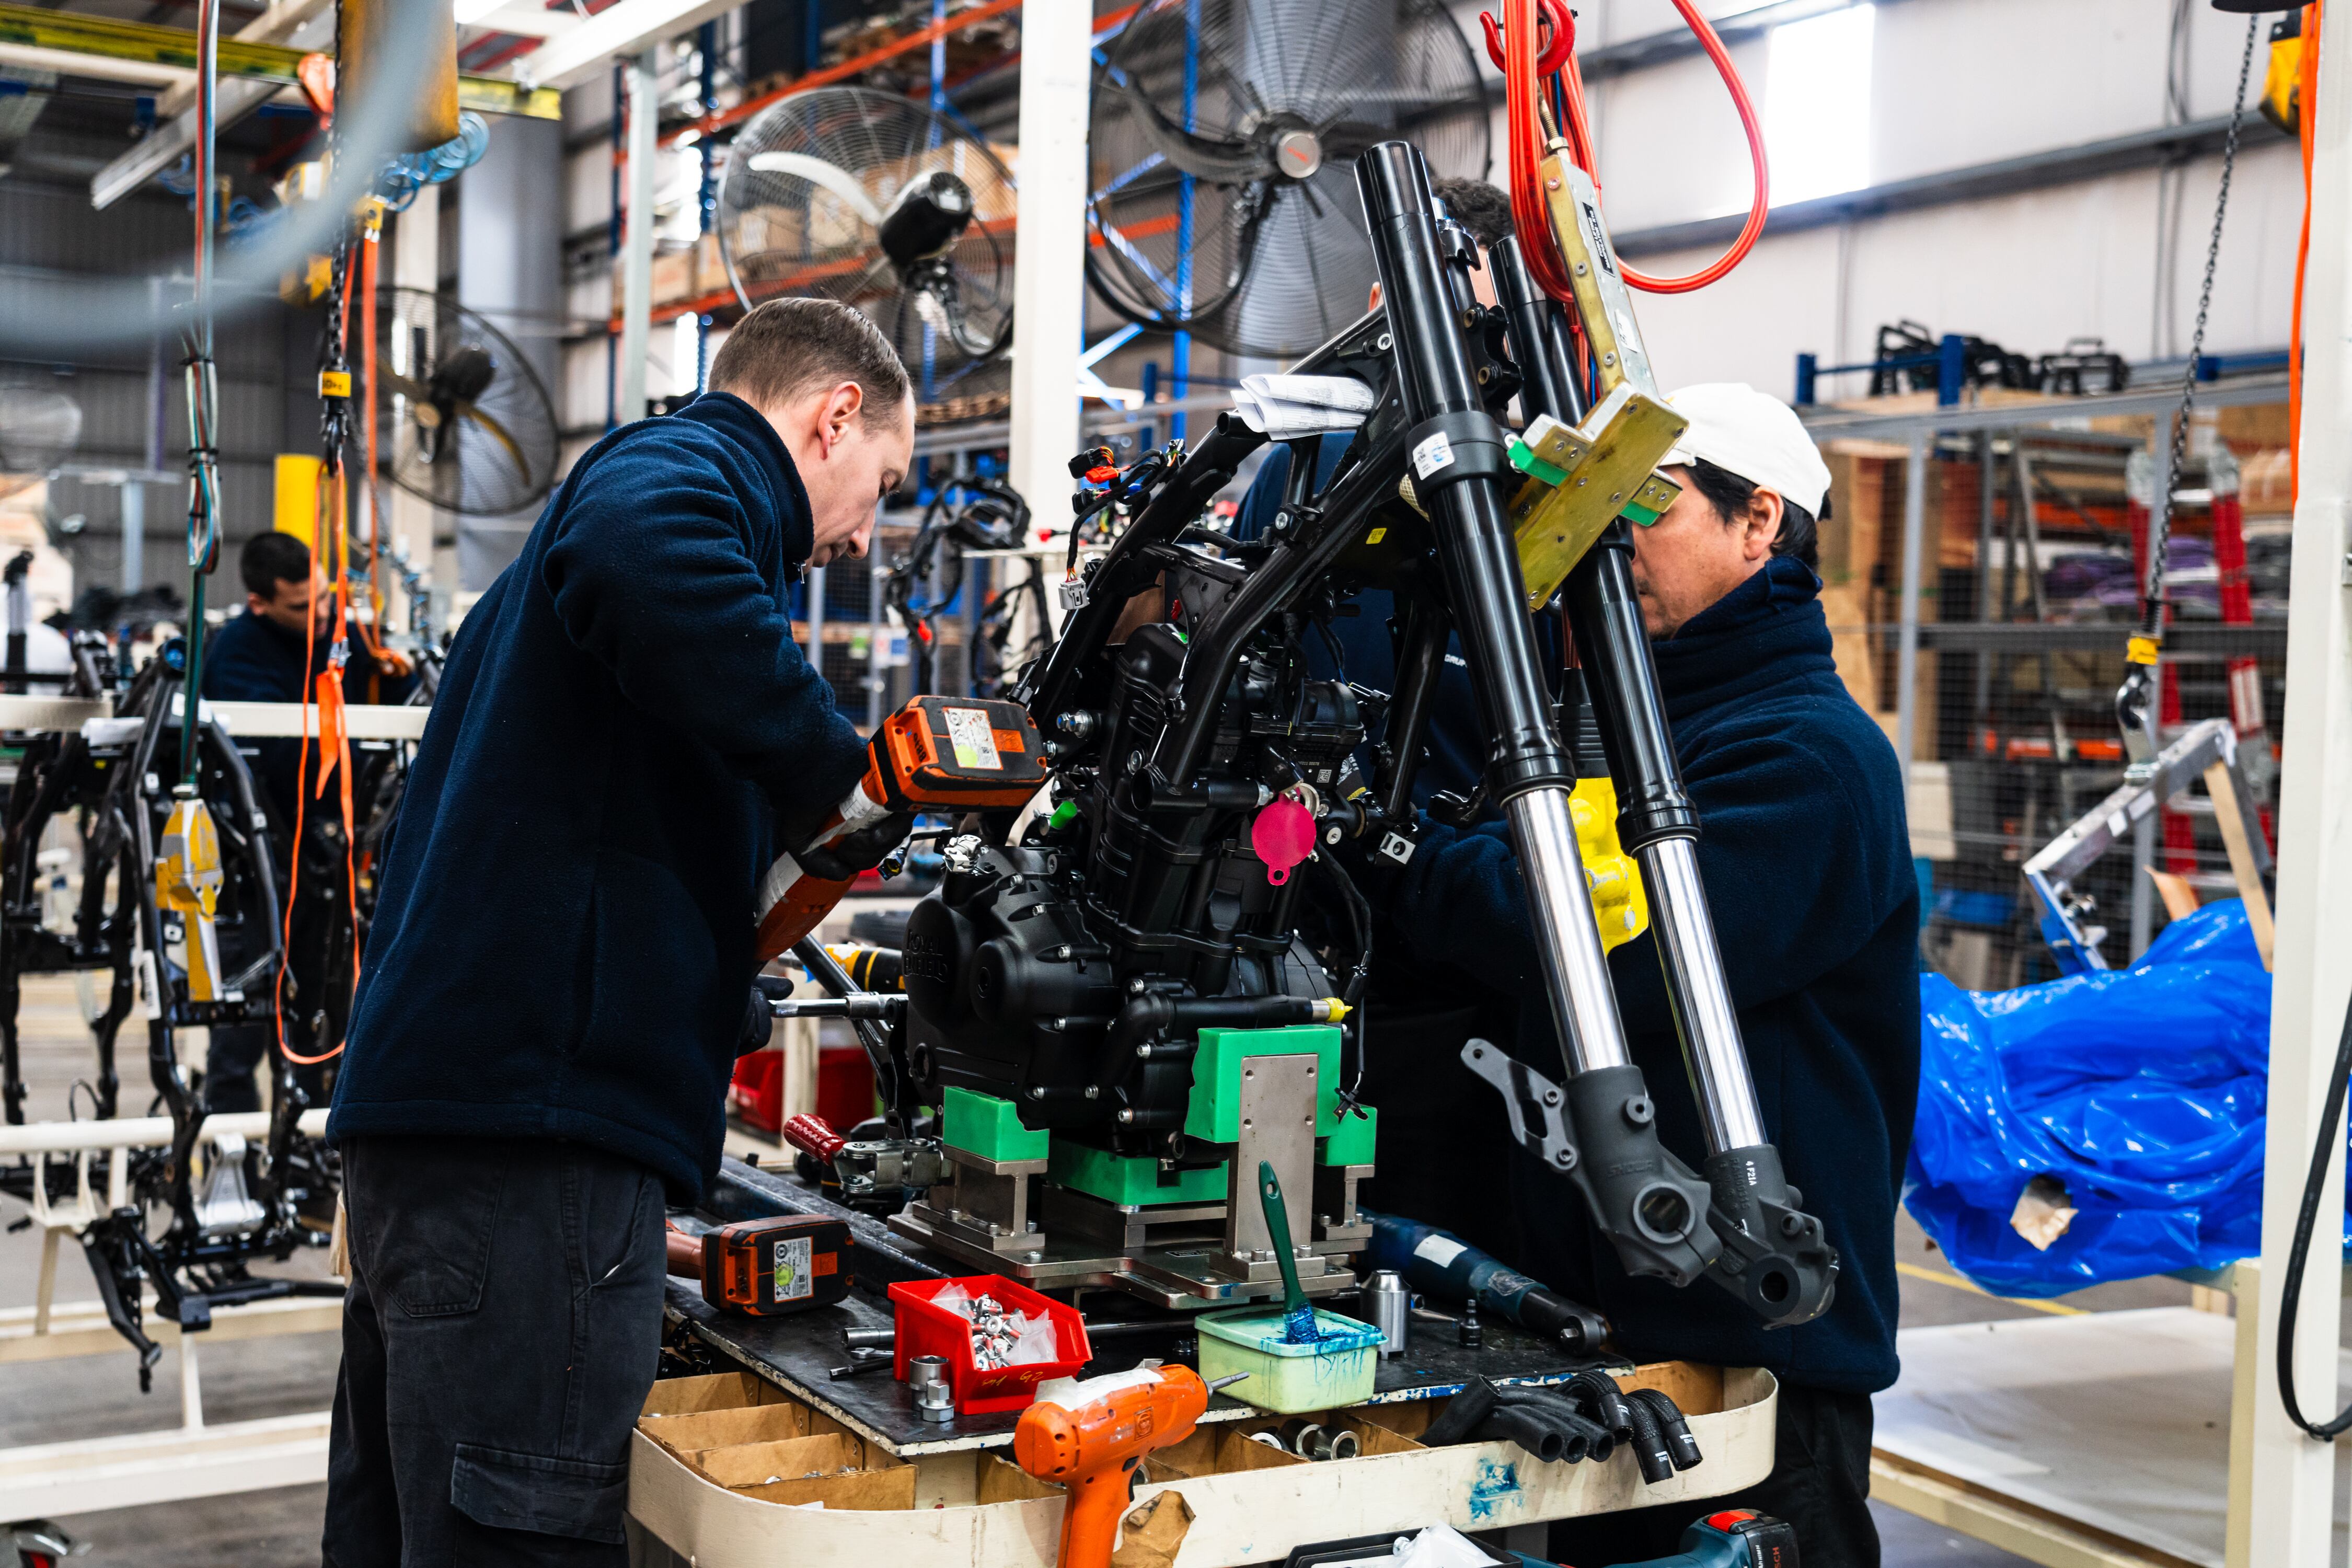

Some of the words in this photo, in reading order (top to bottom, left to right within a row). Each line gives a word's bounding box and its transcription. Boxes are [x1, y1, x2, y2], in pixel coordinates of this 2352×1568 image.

[1587, 217, 1598, 240] LIFTING
[1595, 226, 1611, 269] MANIPULATOR
[1595, 240, 1604, 257] FORK
[1444, 653, 1468, 668] GRUP
